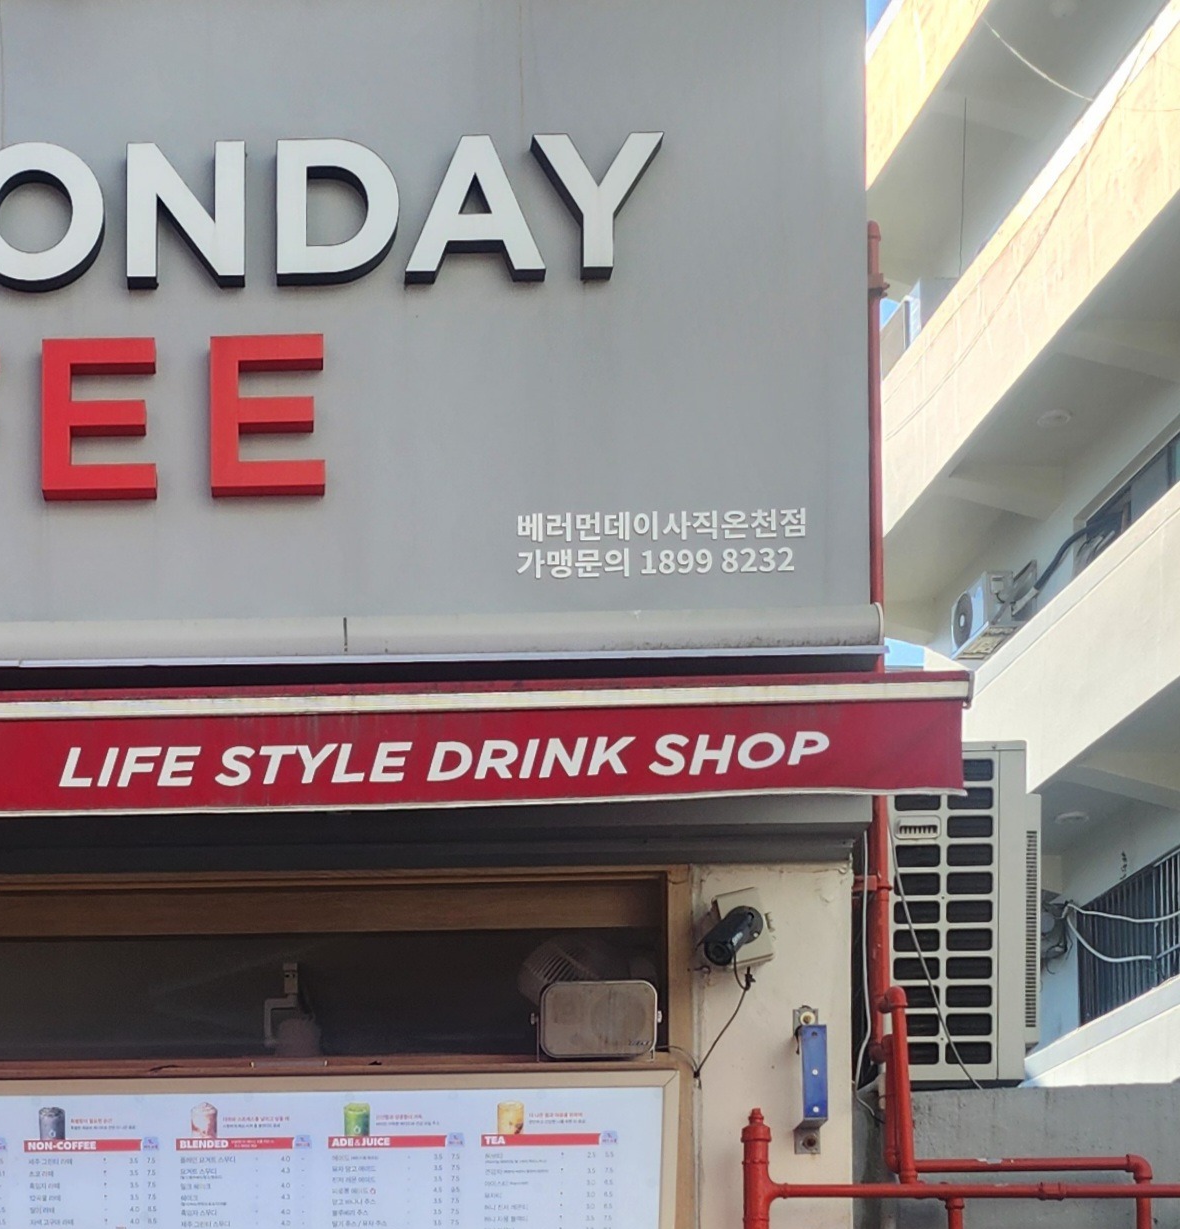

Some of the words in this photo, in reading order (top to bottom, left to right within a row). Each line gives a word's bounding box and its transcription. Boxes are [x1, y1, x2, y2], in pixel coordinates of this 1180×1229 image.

[516, 507, 808, 542] 베러먼데이사직온천점
[516, 547, 632, 578] 가맹문의
[640, 547, 715, 575] 1899
[721, 545, 796, 575] 8232
[59, 745, 202, 788] LIFE
[213, 742, 413, 787] STYLE
[425, 735, 634, 782] DRINK
[648, 730, 830, 777] SHOP
[180, 1140, 229, 1148] BLENDED
[332, 1138, 353, 1146] ADE
[362, 1137, 390, 1146] JUICE
[485, 1136, 505, 1145] TEA
[28, 1141, 96, 1150] NON-COFFEE
